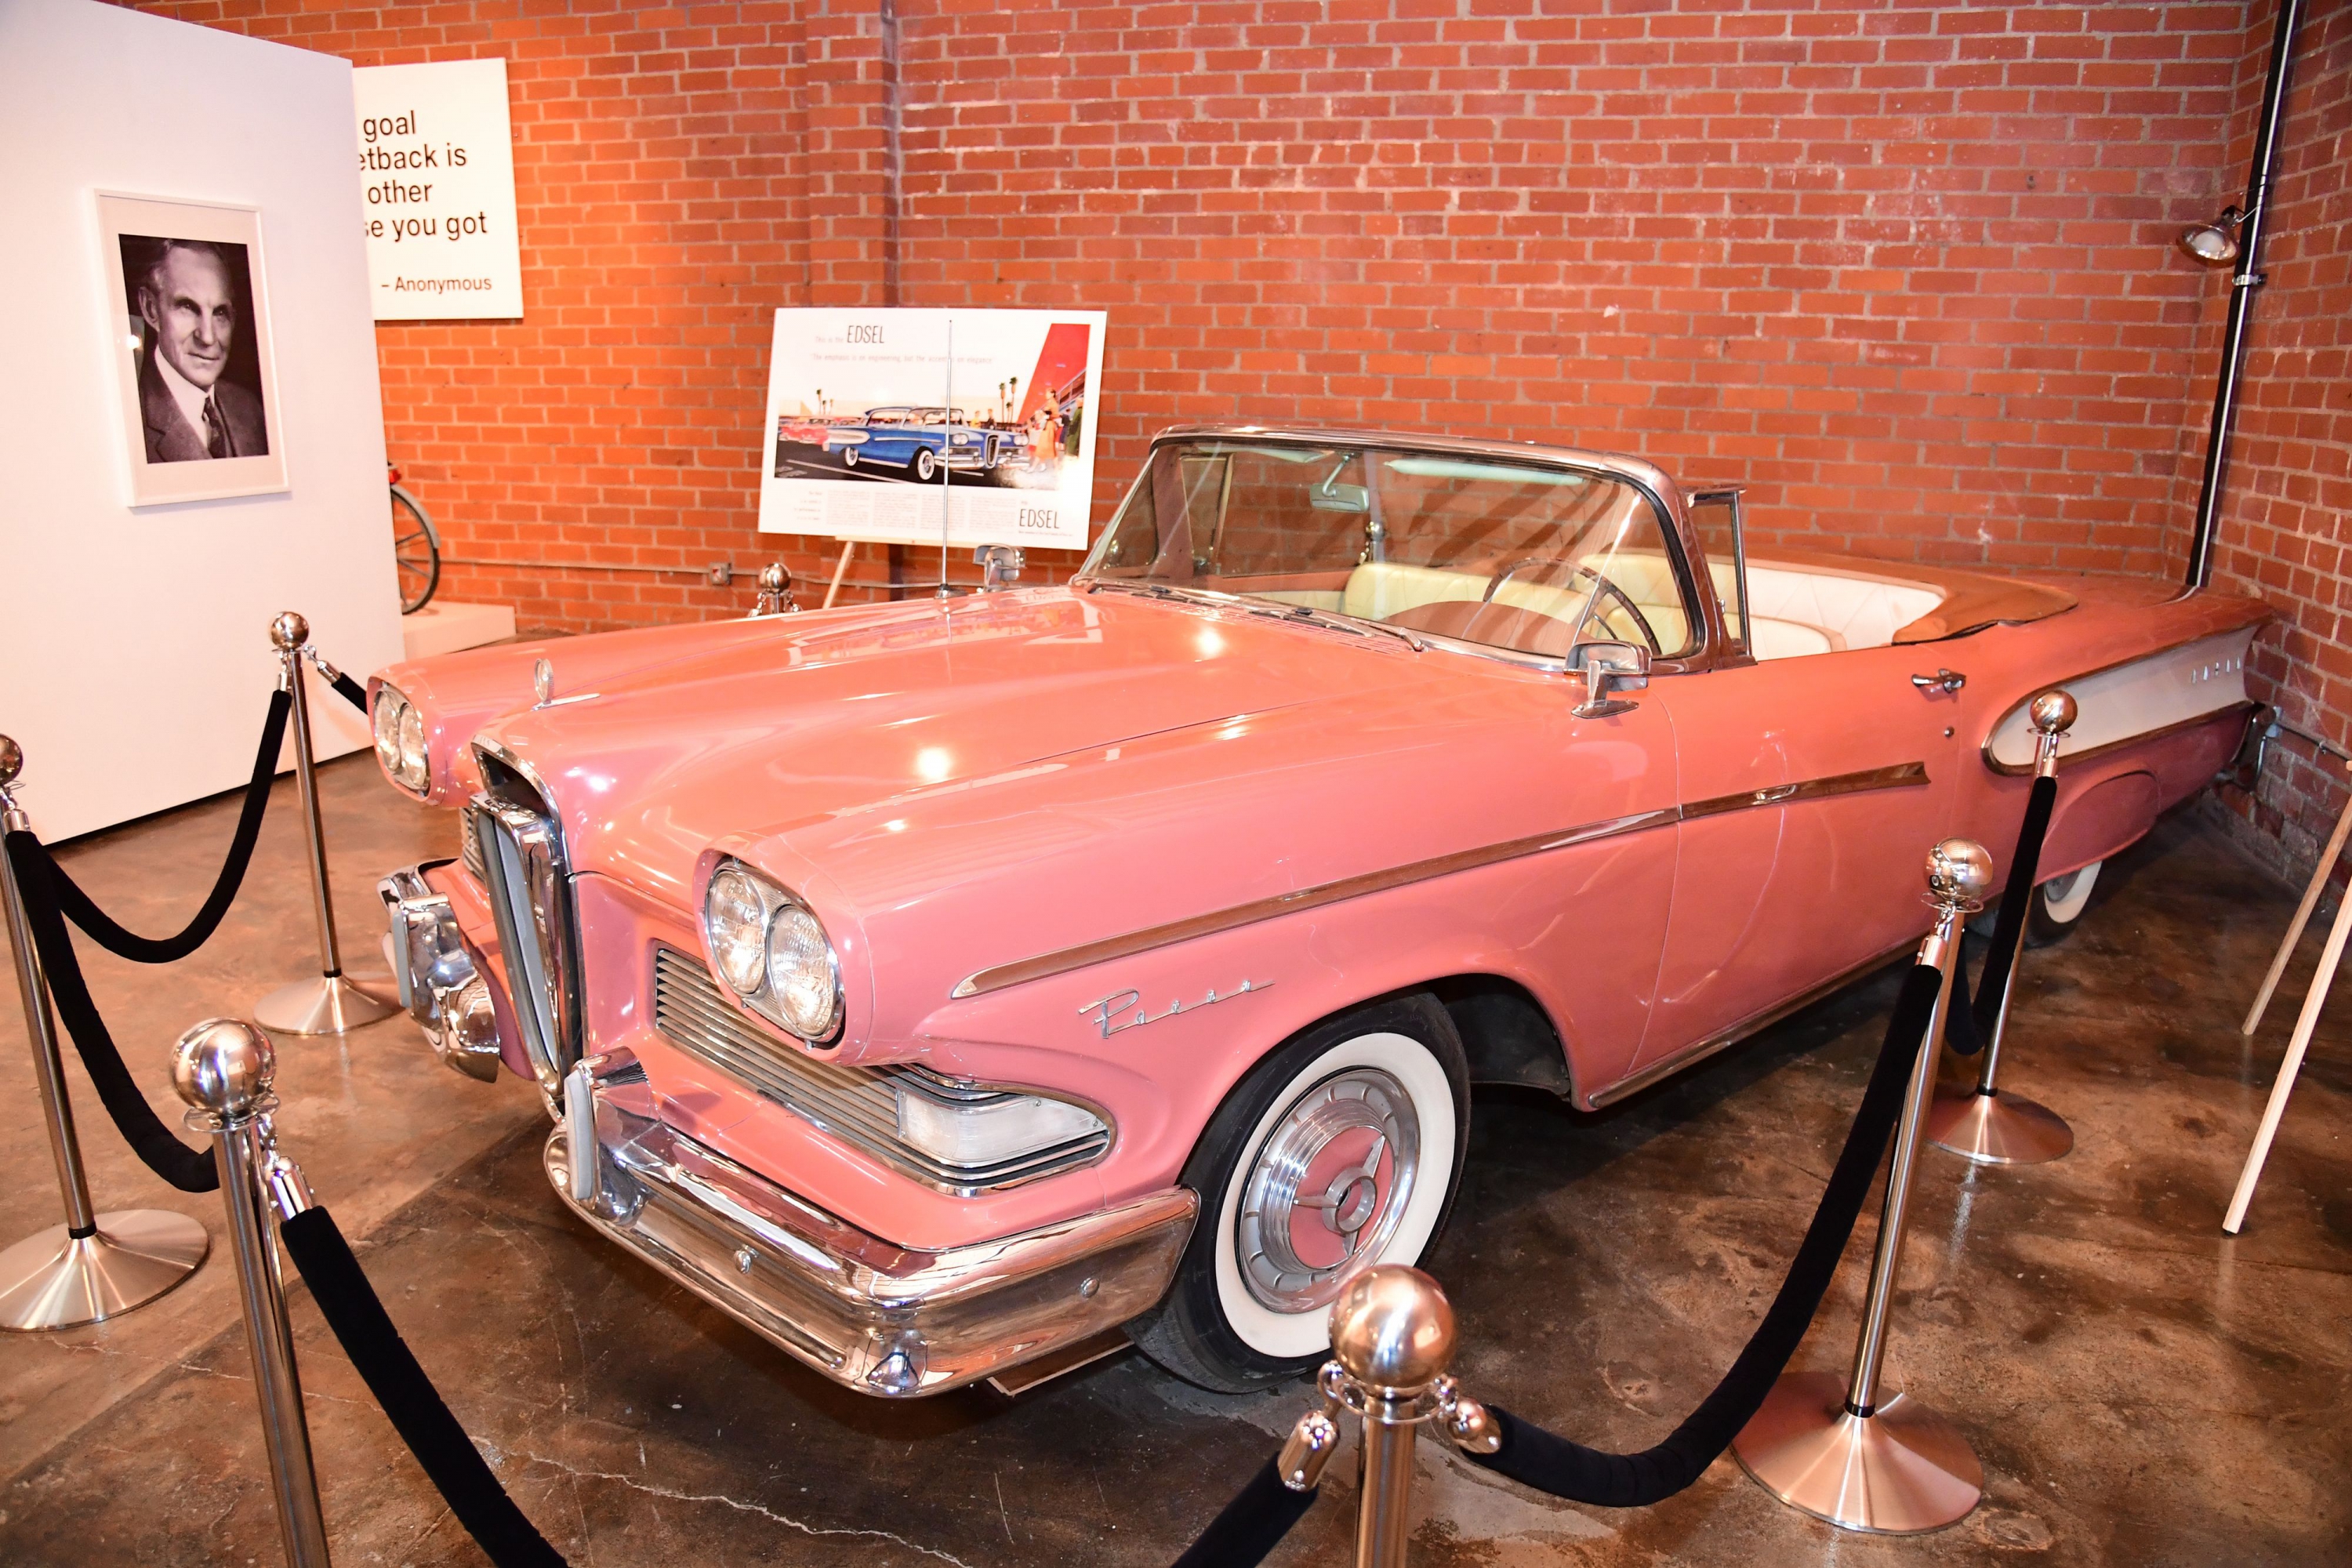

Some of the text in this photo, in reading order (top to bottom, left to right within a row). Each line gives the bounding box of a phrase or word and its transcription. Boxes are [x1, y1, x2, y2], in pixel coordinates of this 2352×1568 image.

[363, 110, 417, 143] goal
[446, 142, 467, 167] is
[368, 180, 433, 204] other
[392, 218, 437, 243] you
[446, 211, 488, 241] got
[395, 276, 492, 294] Anonymous
[847, 325, 885, 344] EDSEL
[1019, 508, 1060, 529] EDSEL
